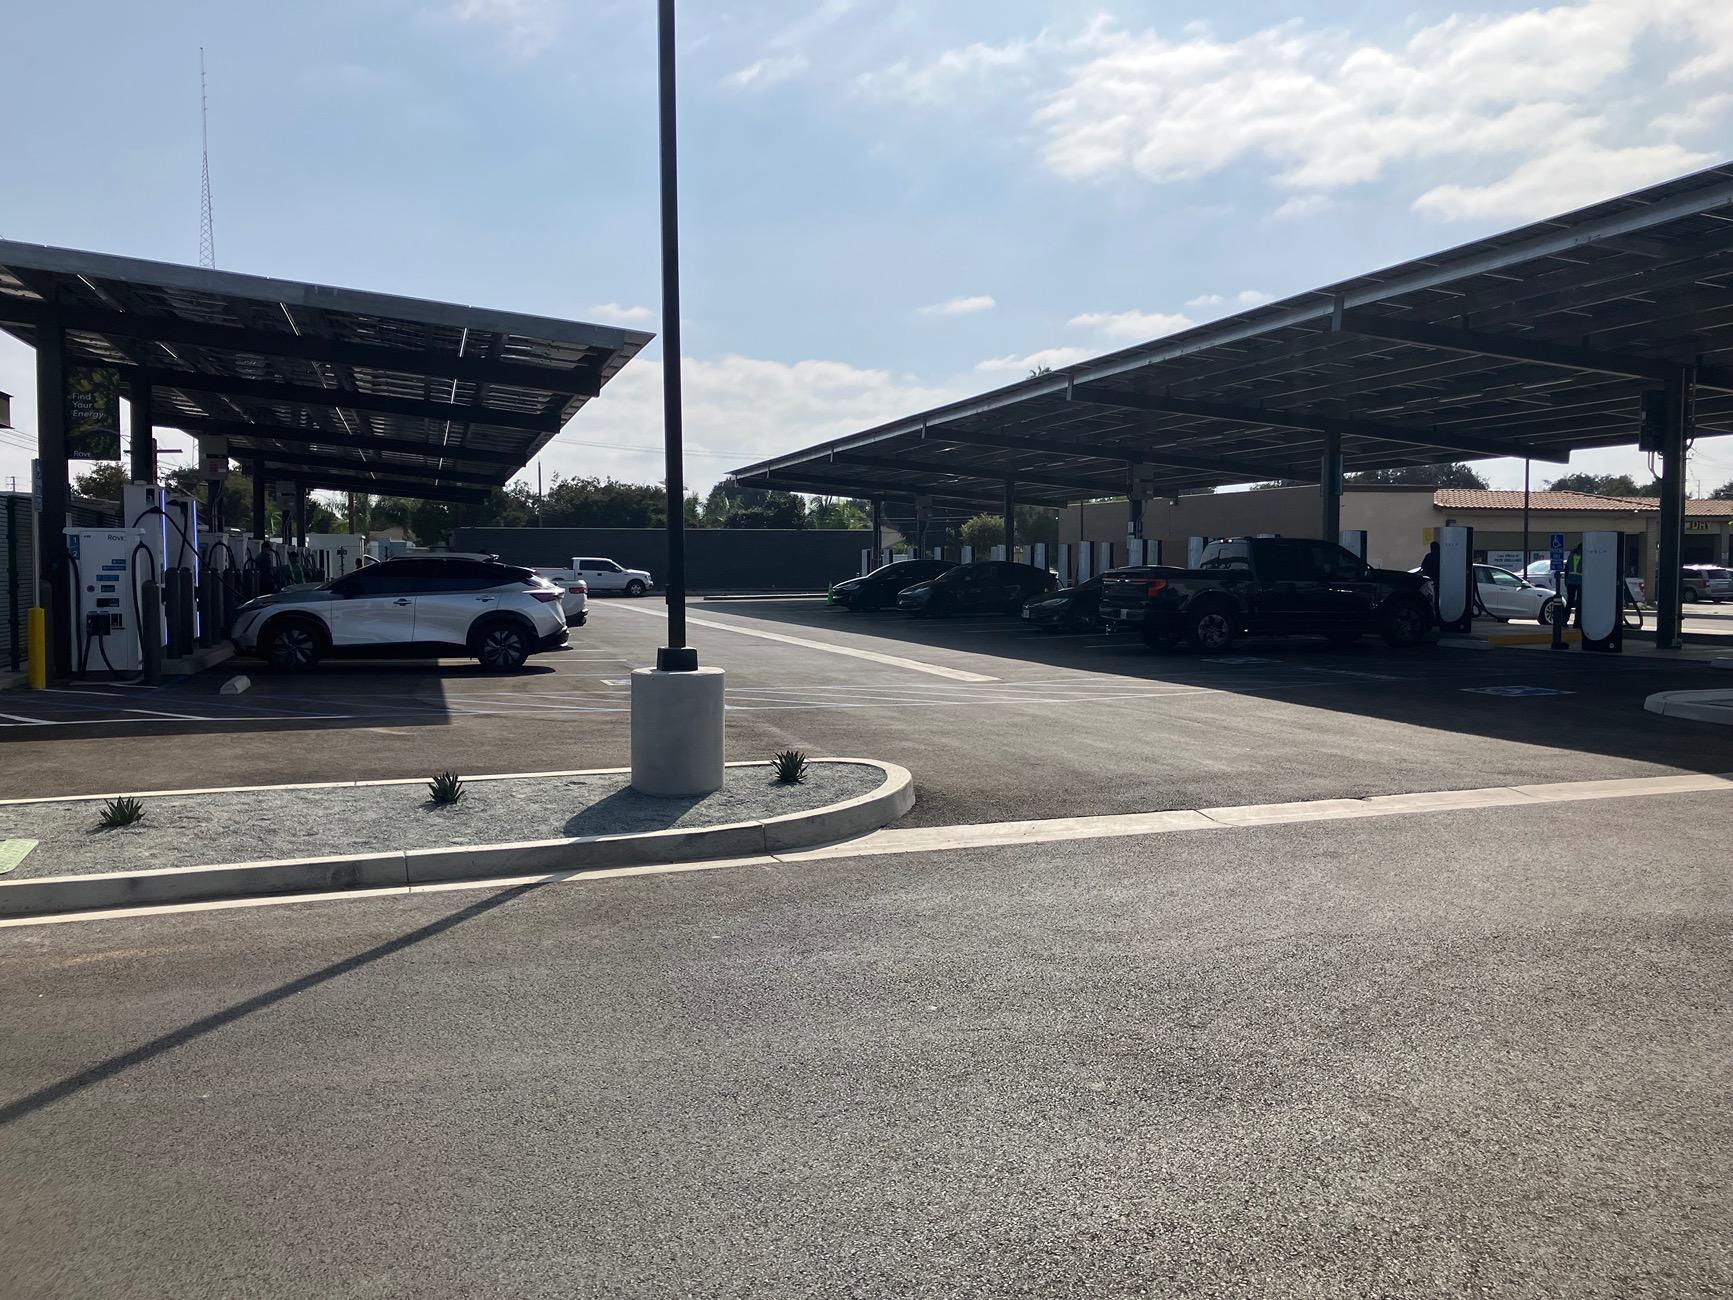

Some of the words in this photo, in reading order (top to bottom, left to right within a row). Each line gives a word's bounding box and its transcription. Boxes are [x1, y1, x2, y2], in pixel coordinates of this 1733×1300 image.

[72, 392, 92, 401] Find
[72, 401, 93, 409] Your
[72, 410, 104, 419] Energy
